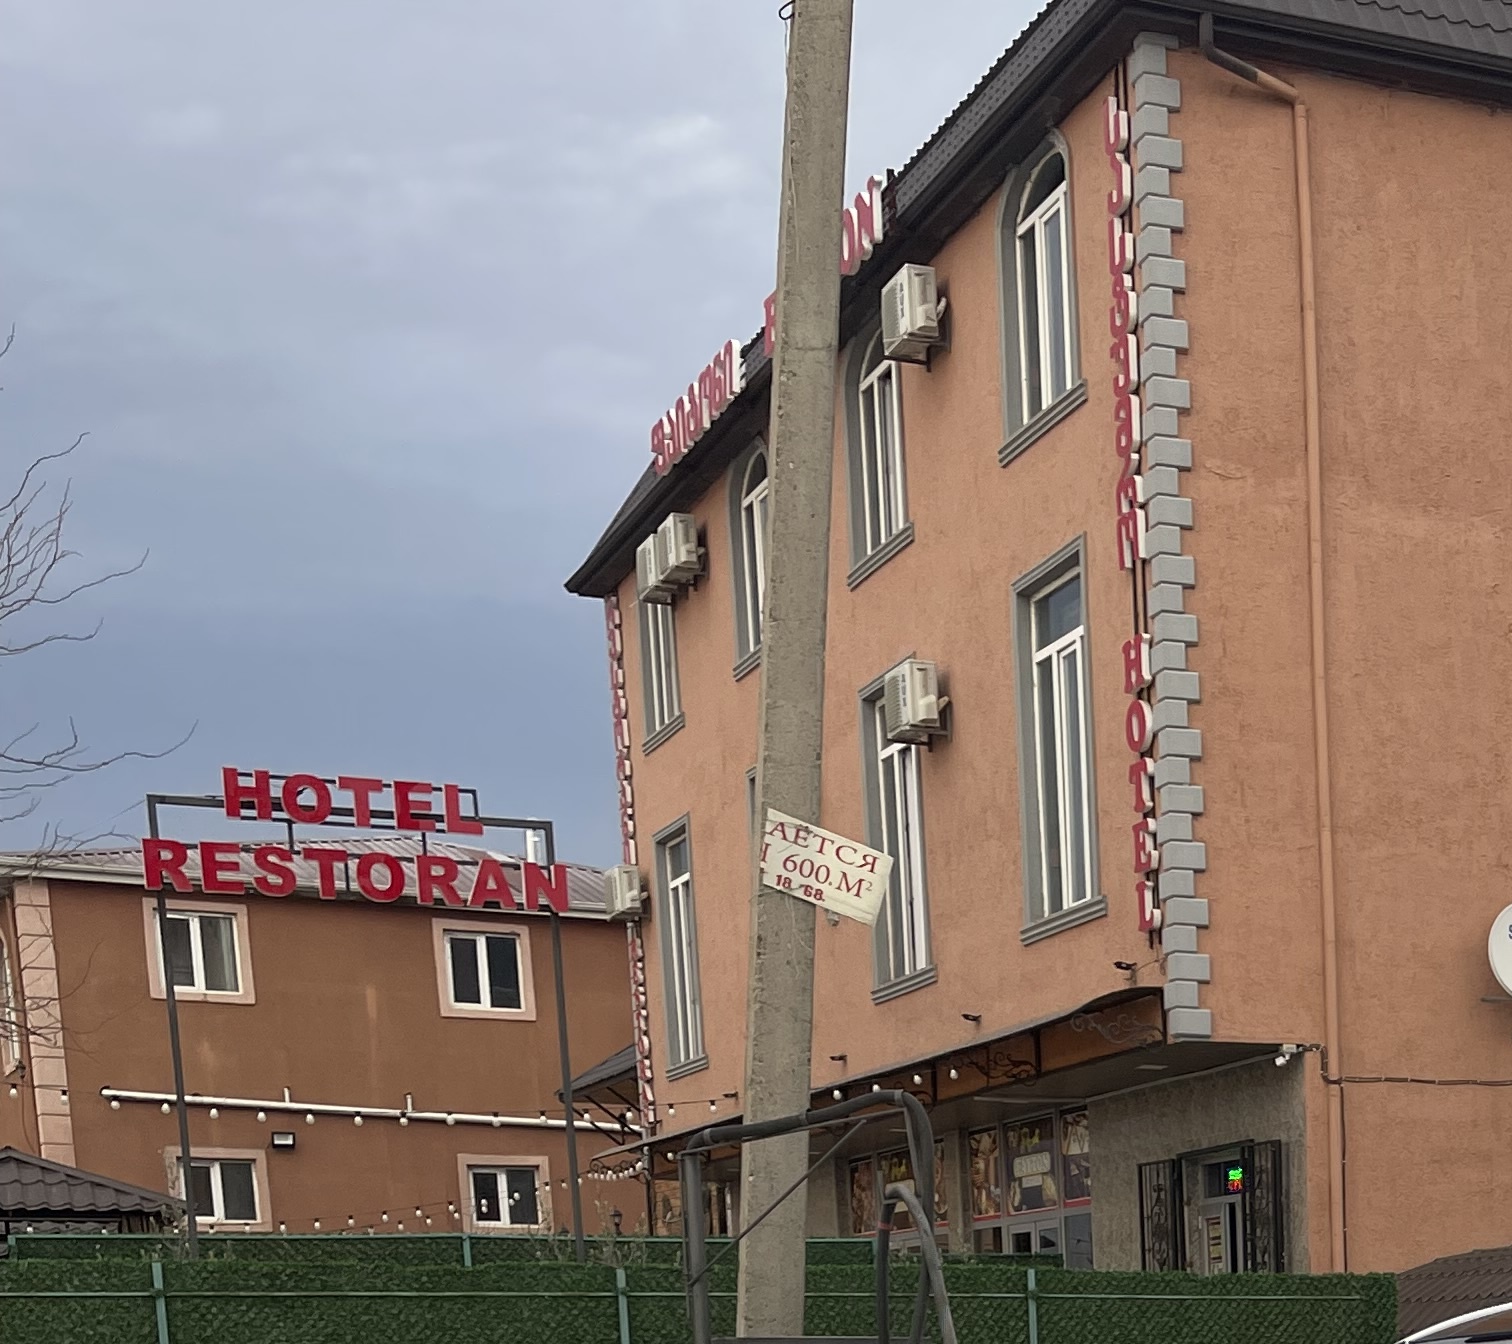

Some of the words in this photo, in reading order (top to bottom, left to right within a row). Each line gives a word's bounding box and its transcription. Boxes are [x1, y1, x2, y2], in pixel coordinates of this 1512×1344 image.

[222, 766, 484, 835] HOTEL
[1122, 633, 1161, 932] HOTEL
[141, 837, 570, 913] RESTORAN
